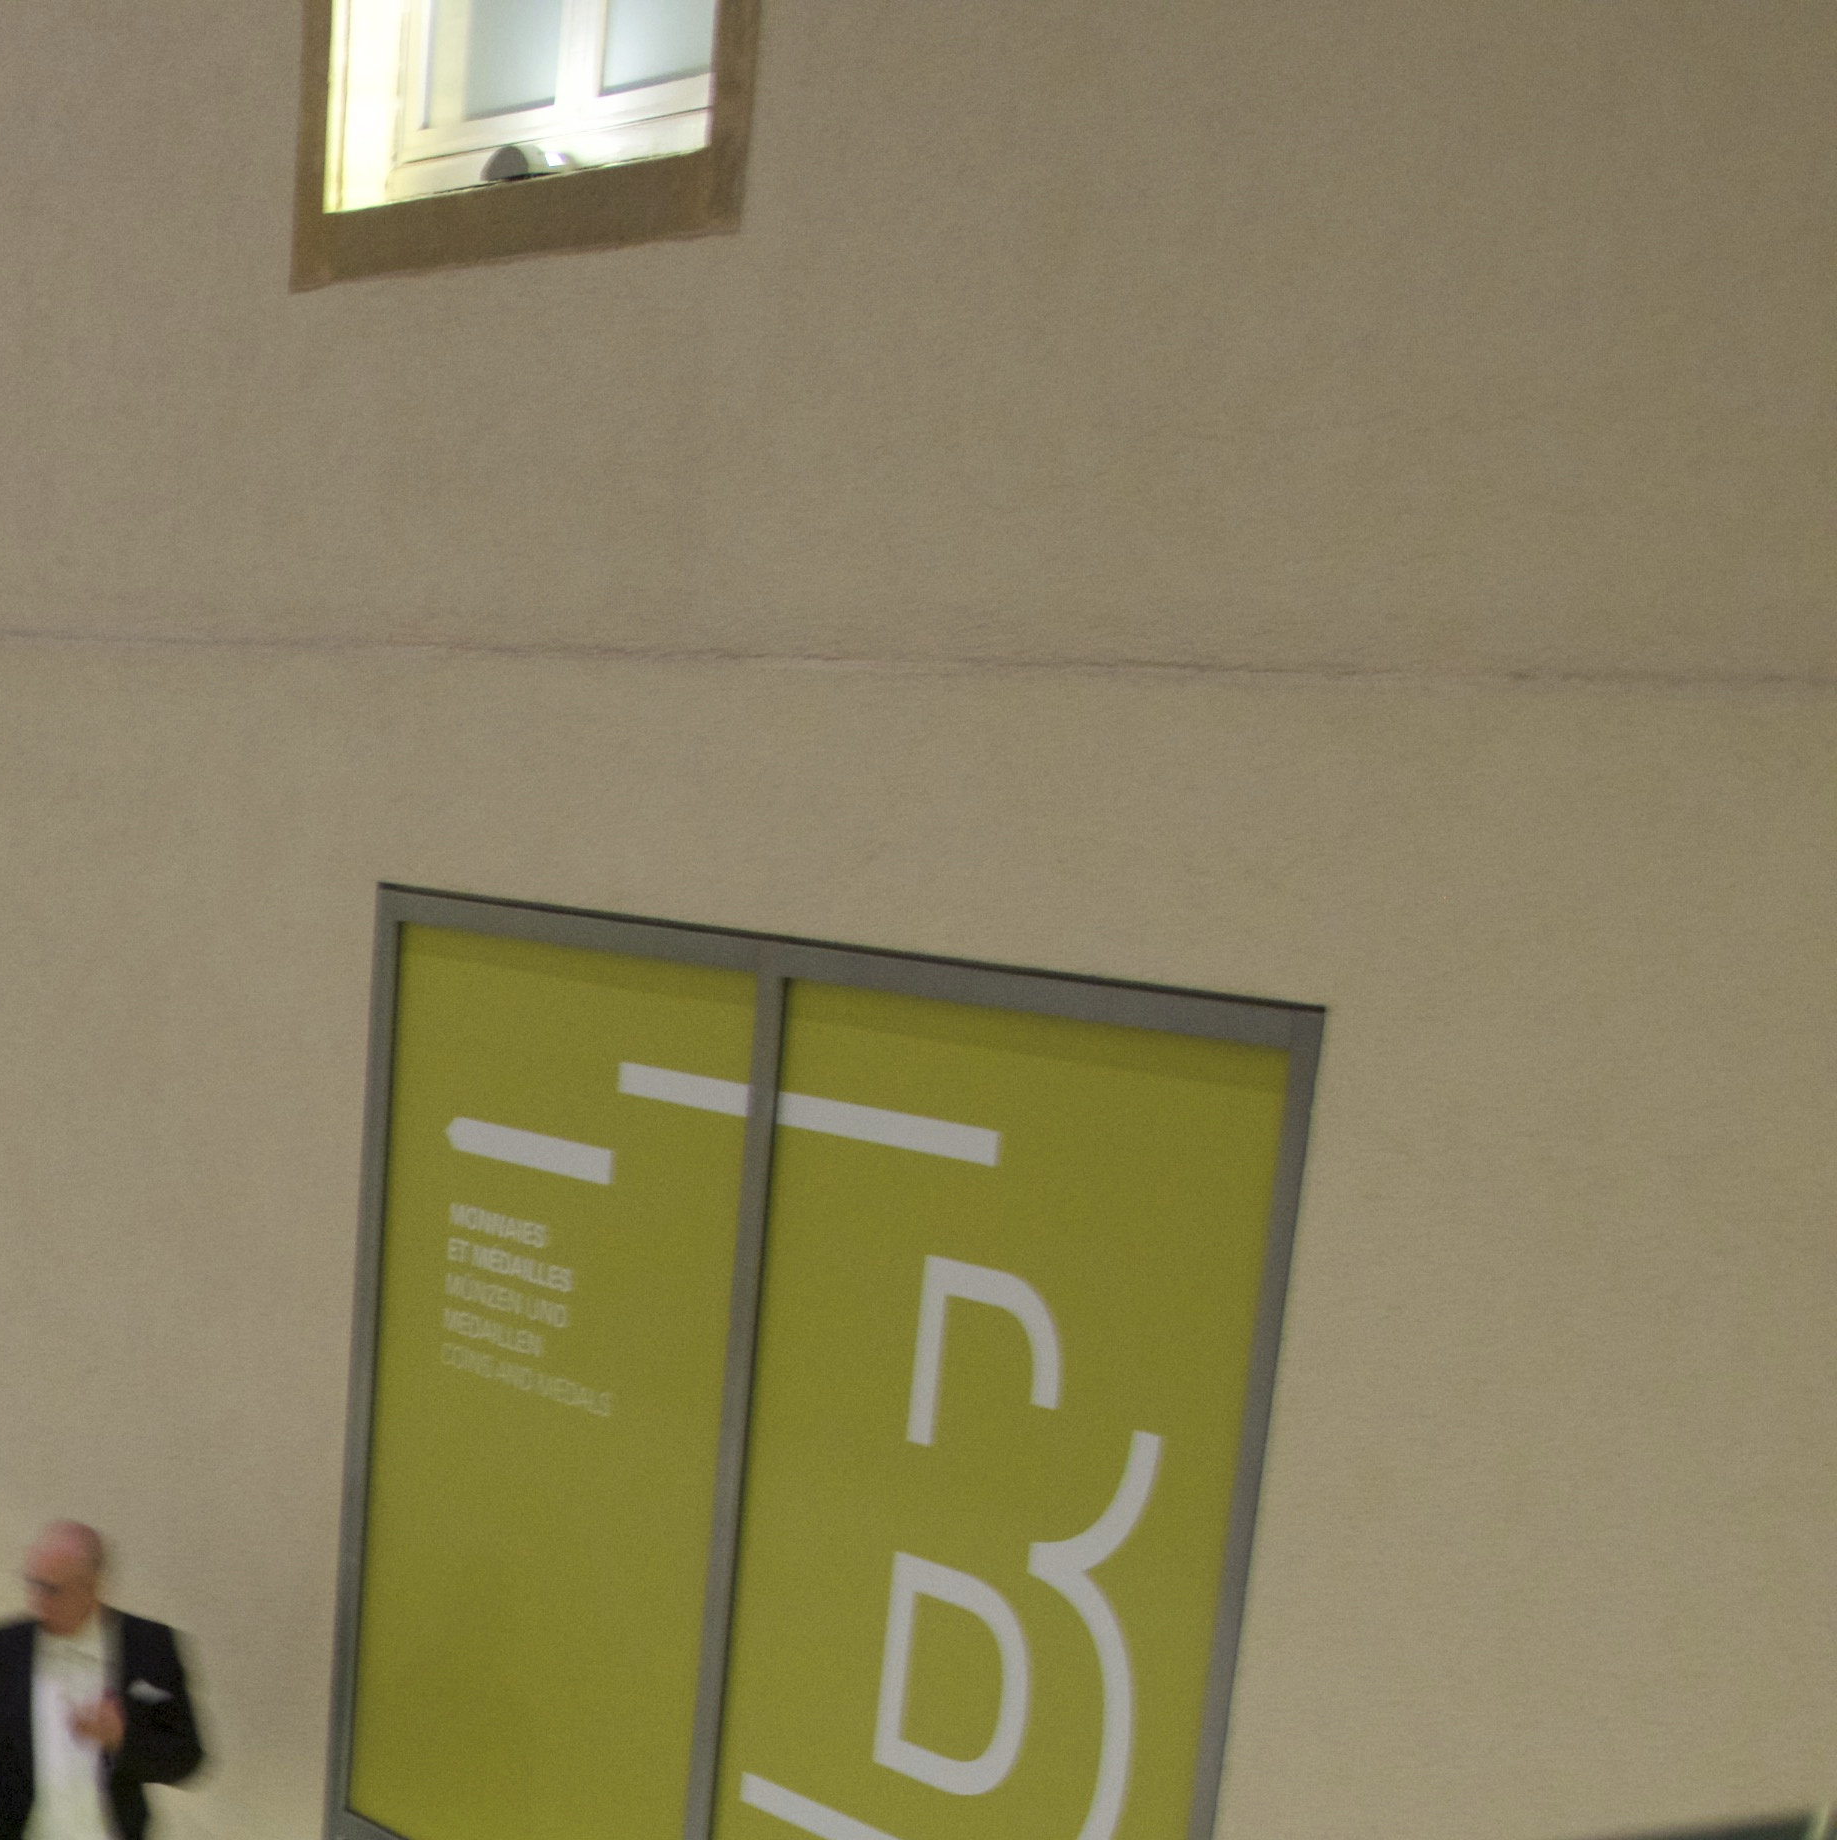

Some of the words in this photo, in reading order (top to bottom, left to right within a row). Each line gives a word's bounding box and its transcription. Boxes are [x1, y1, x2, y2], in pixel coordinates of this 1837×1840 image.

[449, 1203, 548, 1249] MONNAIES
[447, 1237, 469, 1263] ET
[472, 1242, 574, 1293] MÉDAILLES
